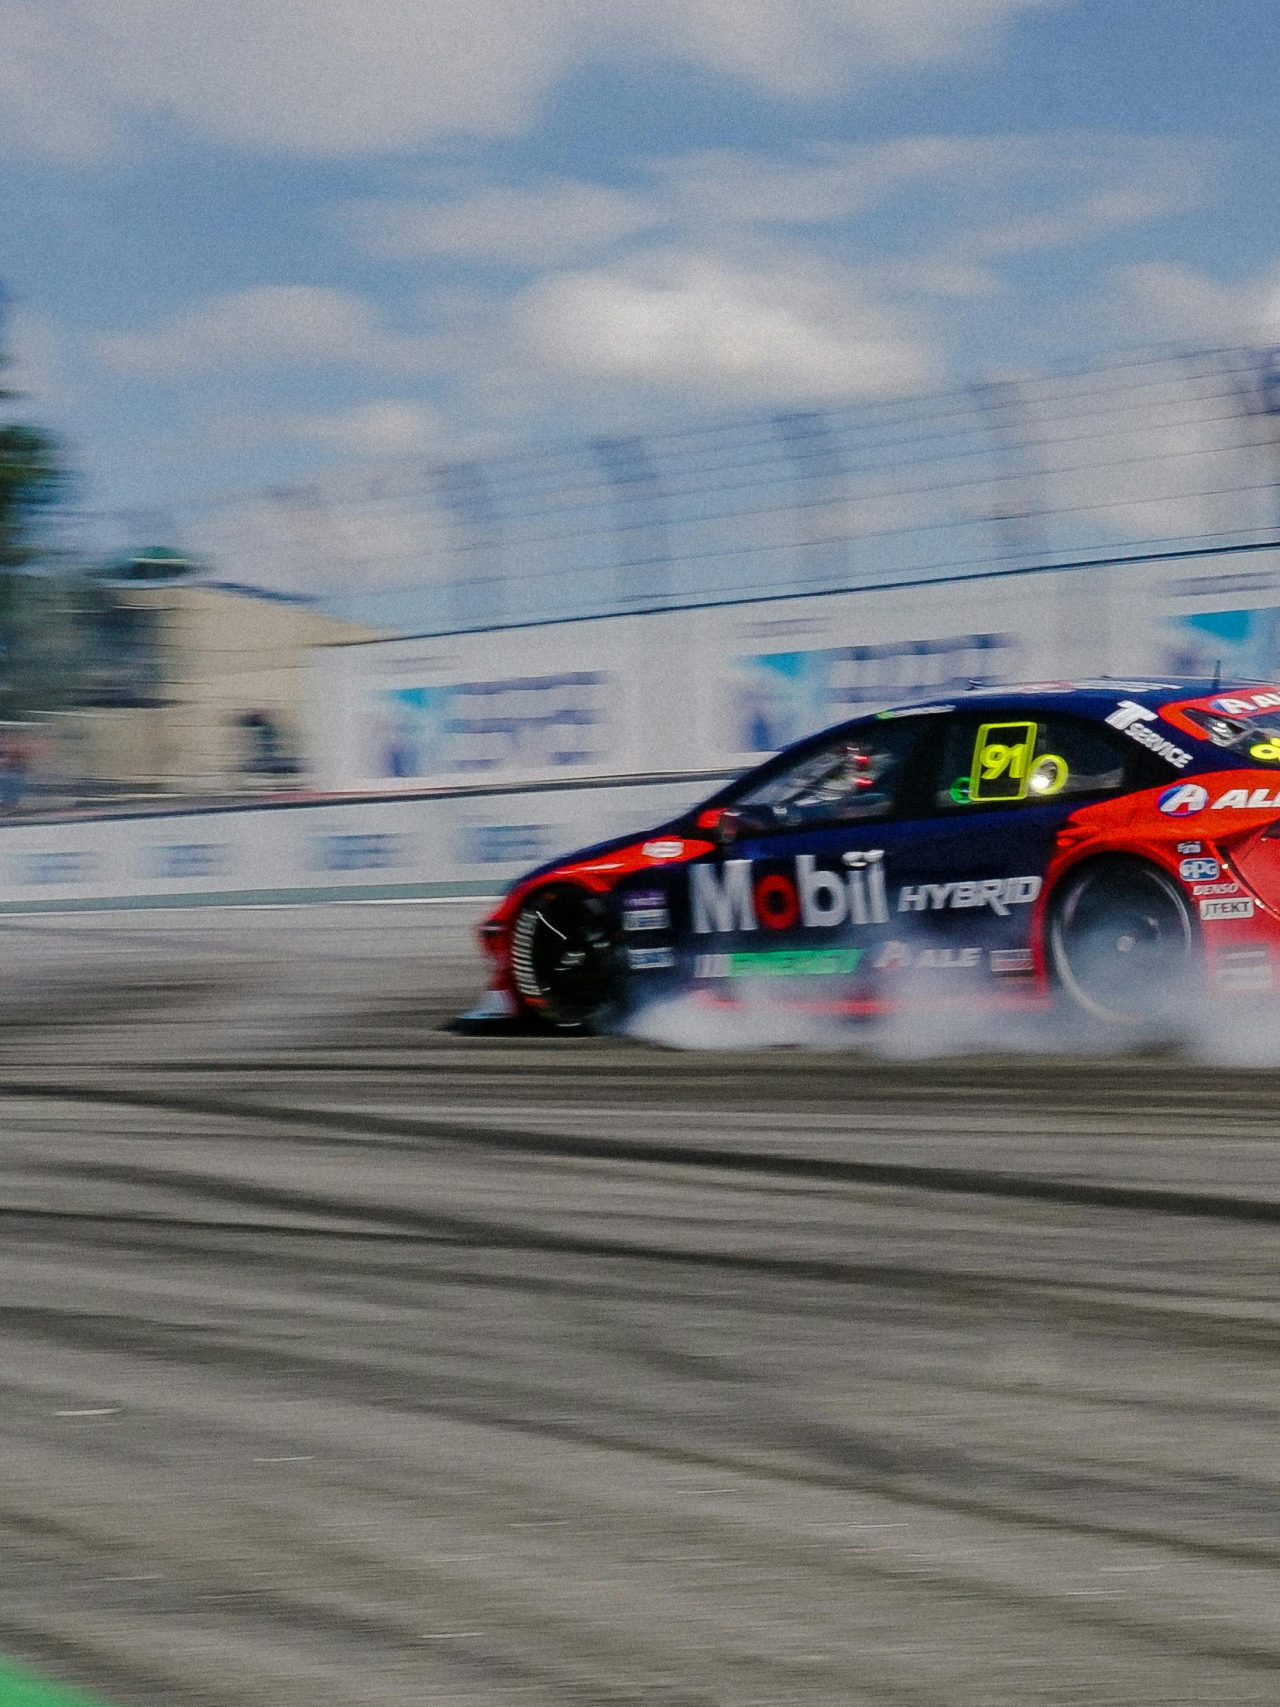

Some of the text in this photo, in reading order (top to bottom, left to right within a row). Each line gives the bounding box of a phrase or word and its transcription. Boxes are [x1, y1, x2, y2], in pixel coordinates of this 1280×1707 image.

[980, 743, 1029, 780] 91
[1124, 722, 1193, 769] SERVICE
[688, 850, 1042, 934] Mobil HYBRID
[1203, 901, 1250, 918] JTEKT
